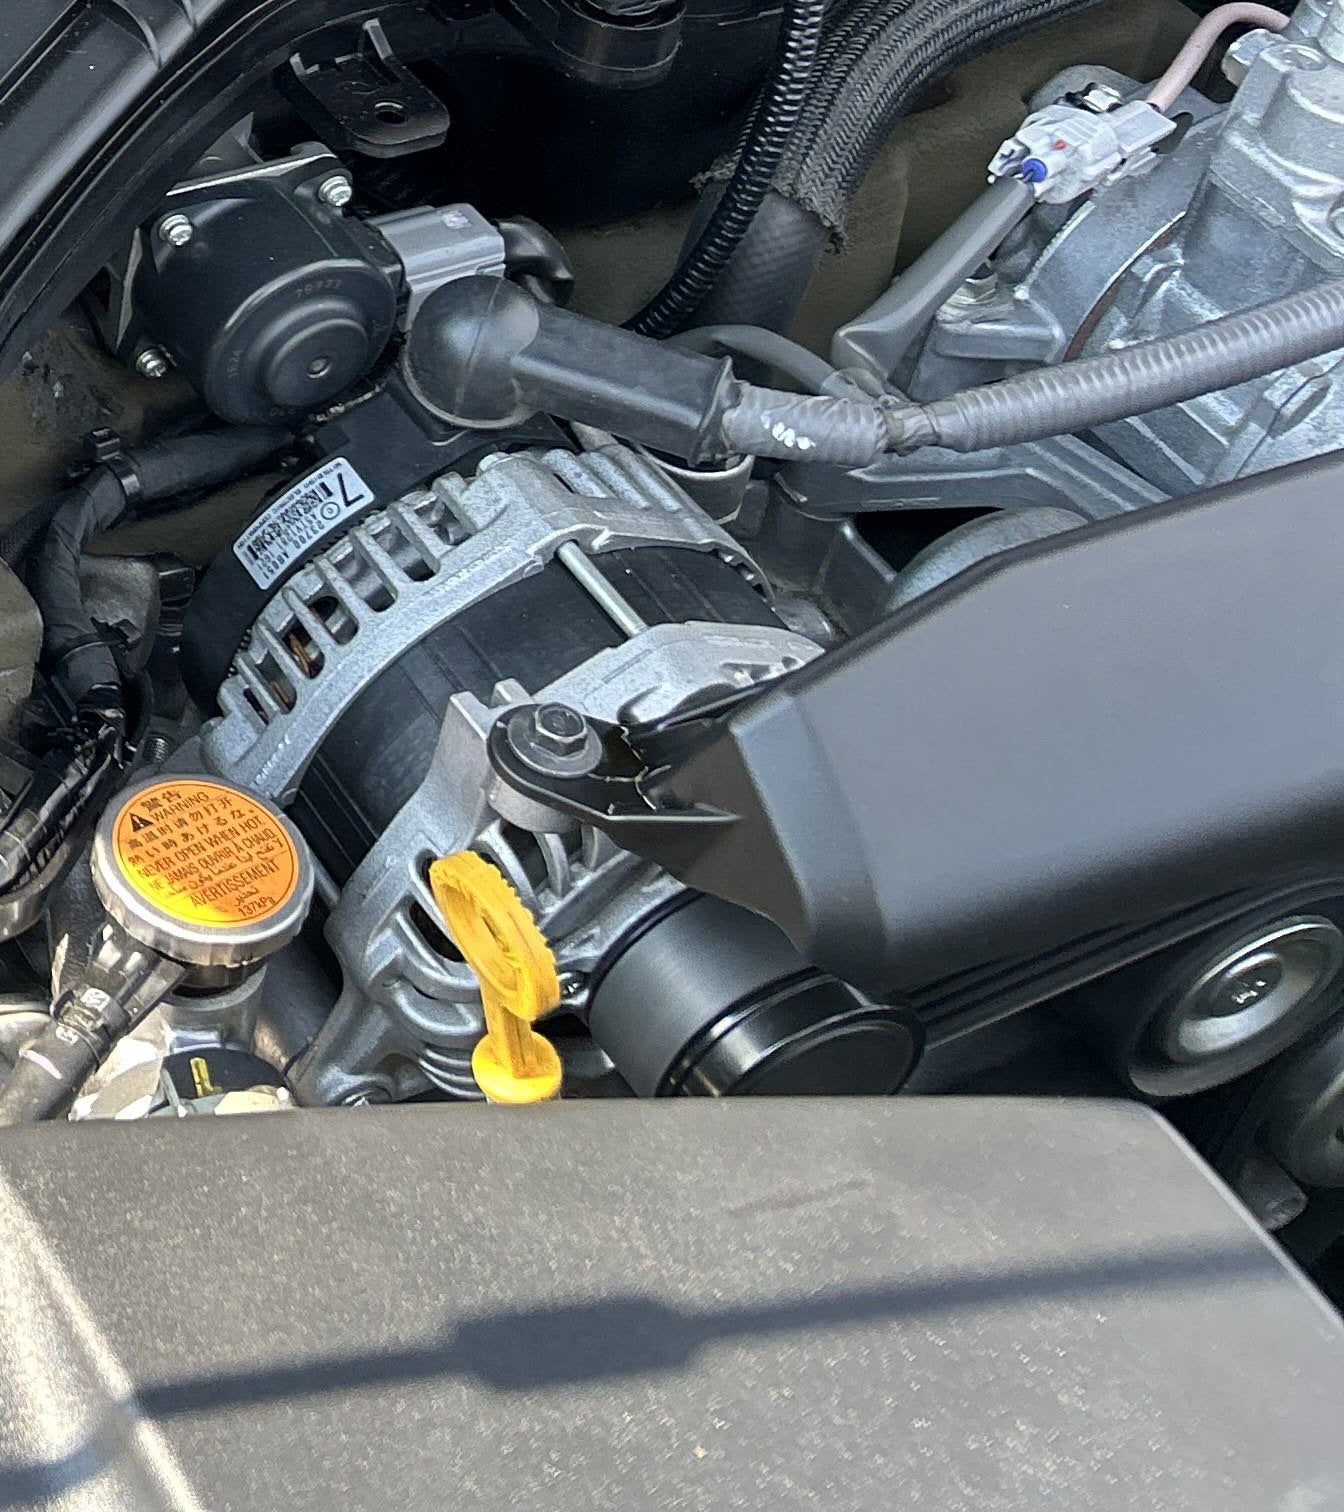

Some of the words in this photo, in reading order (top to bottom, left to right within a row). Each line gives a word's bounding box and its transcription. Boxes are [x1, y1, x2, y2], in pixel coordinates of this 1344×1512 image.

[150, 791, 210, 823] WARNING
[137, 855, 175, 878] NEVER
[174, 841, 207, 862] OPEN
[206, 826, 239, 849] WHEN
[165, 862, 199, 885] JAMAIS
[198, 846, 234, 871] OUVRIR
[189, 859, 280, 908] AVERTISSEMENT
